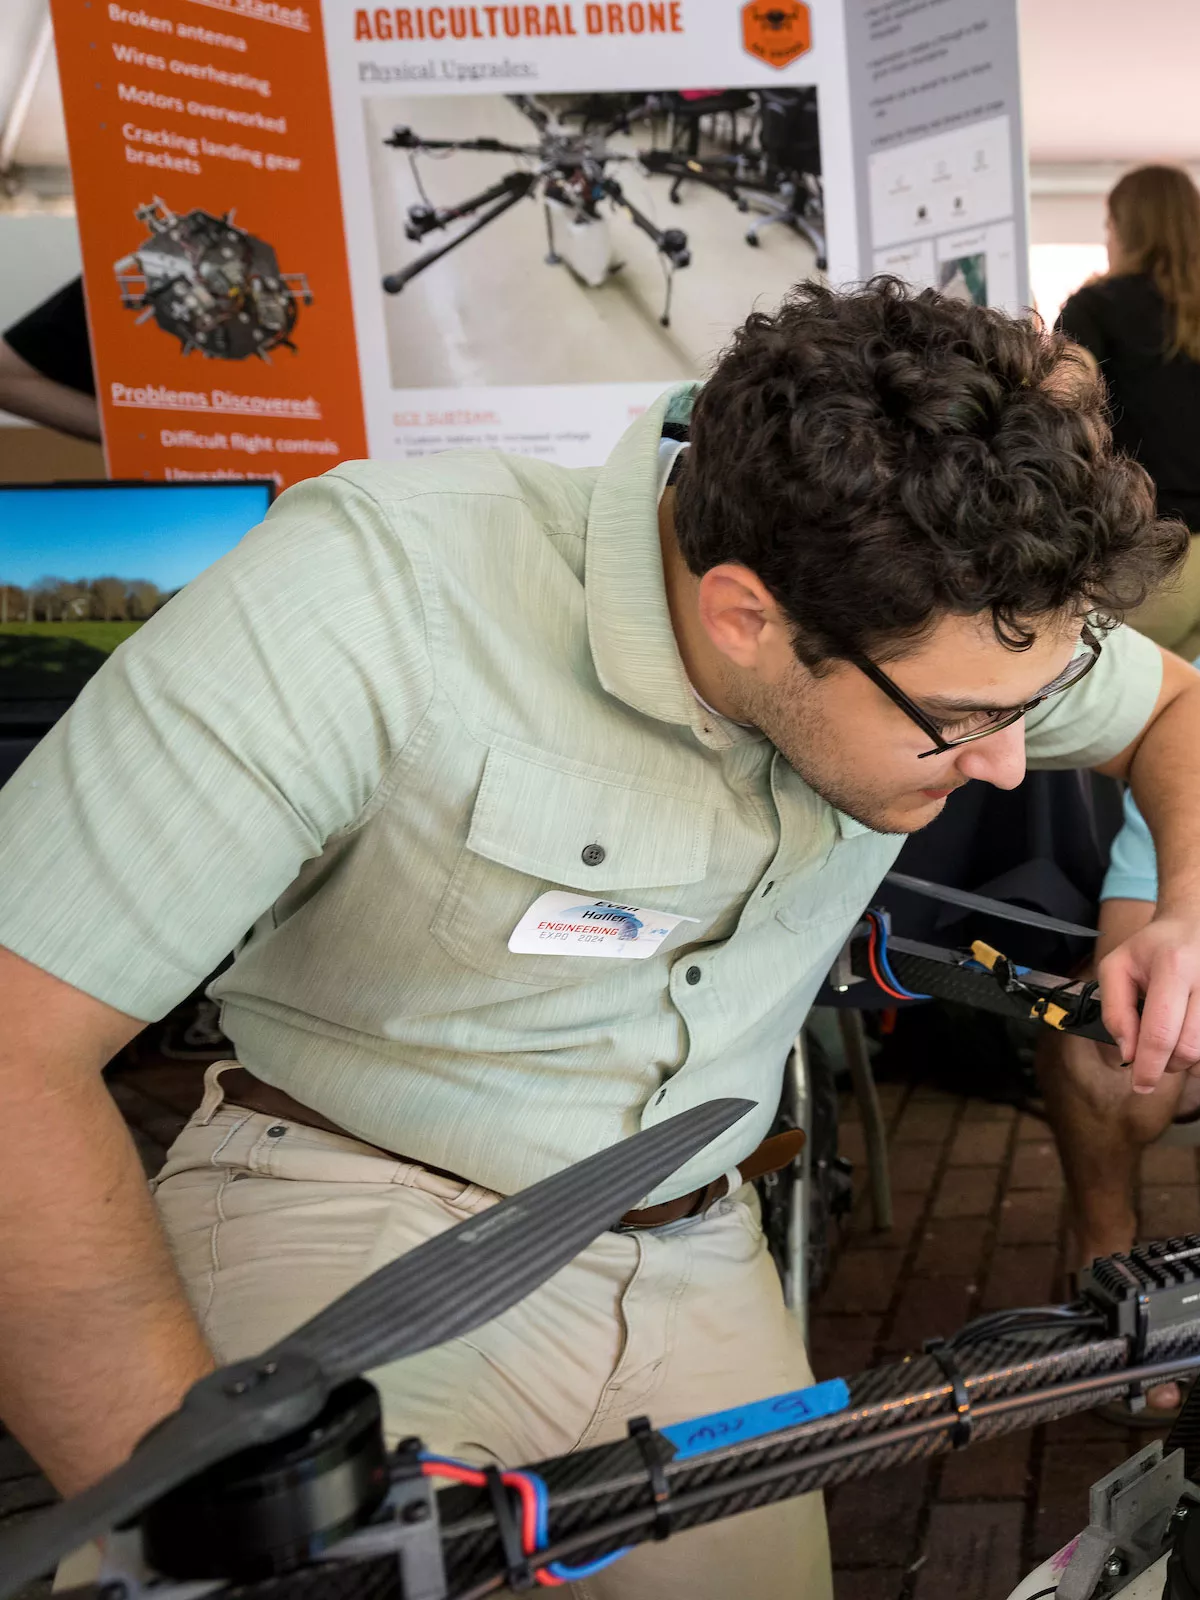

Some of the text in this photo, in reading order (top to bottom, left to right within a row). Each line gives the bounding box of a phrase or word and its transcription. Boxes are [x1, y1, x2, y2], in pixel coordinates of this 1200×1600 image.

[108, 3, 248, 52] Broken antenna
[354, 1, 684, 41] AGRICULTURAL DRONE
[112, 43, 272, 97] Wires overheating
[358, 58, 436, 83] Physical
[117, 82, 287, 133] Motors overworked
[122, 122, 301, 172] Cracking landing gear
[125, 145, 201, 175] brackets
[111, 382, 322, 420] Problems Discovered:
[160, 429, 340, 456] Difficult flight controls
[593, 900, 640, 912] Evan
[537, 921, 620, 937] ENGINEERING
[539, 931, 605, 943] EXPO 2024
